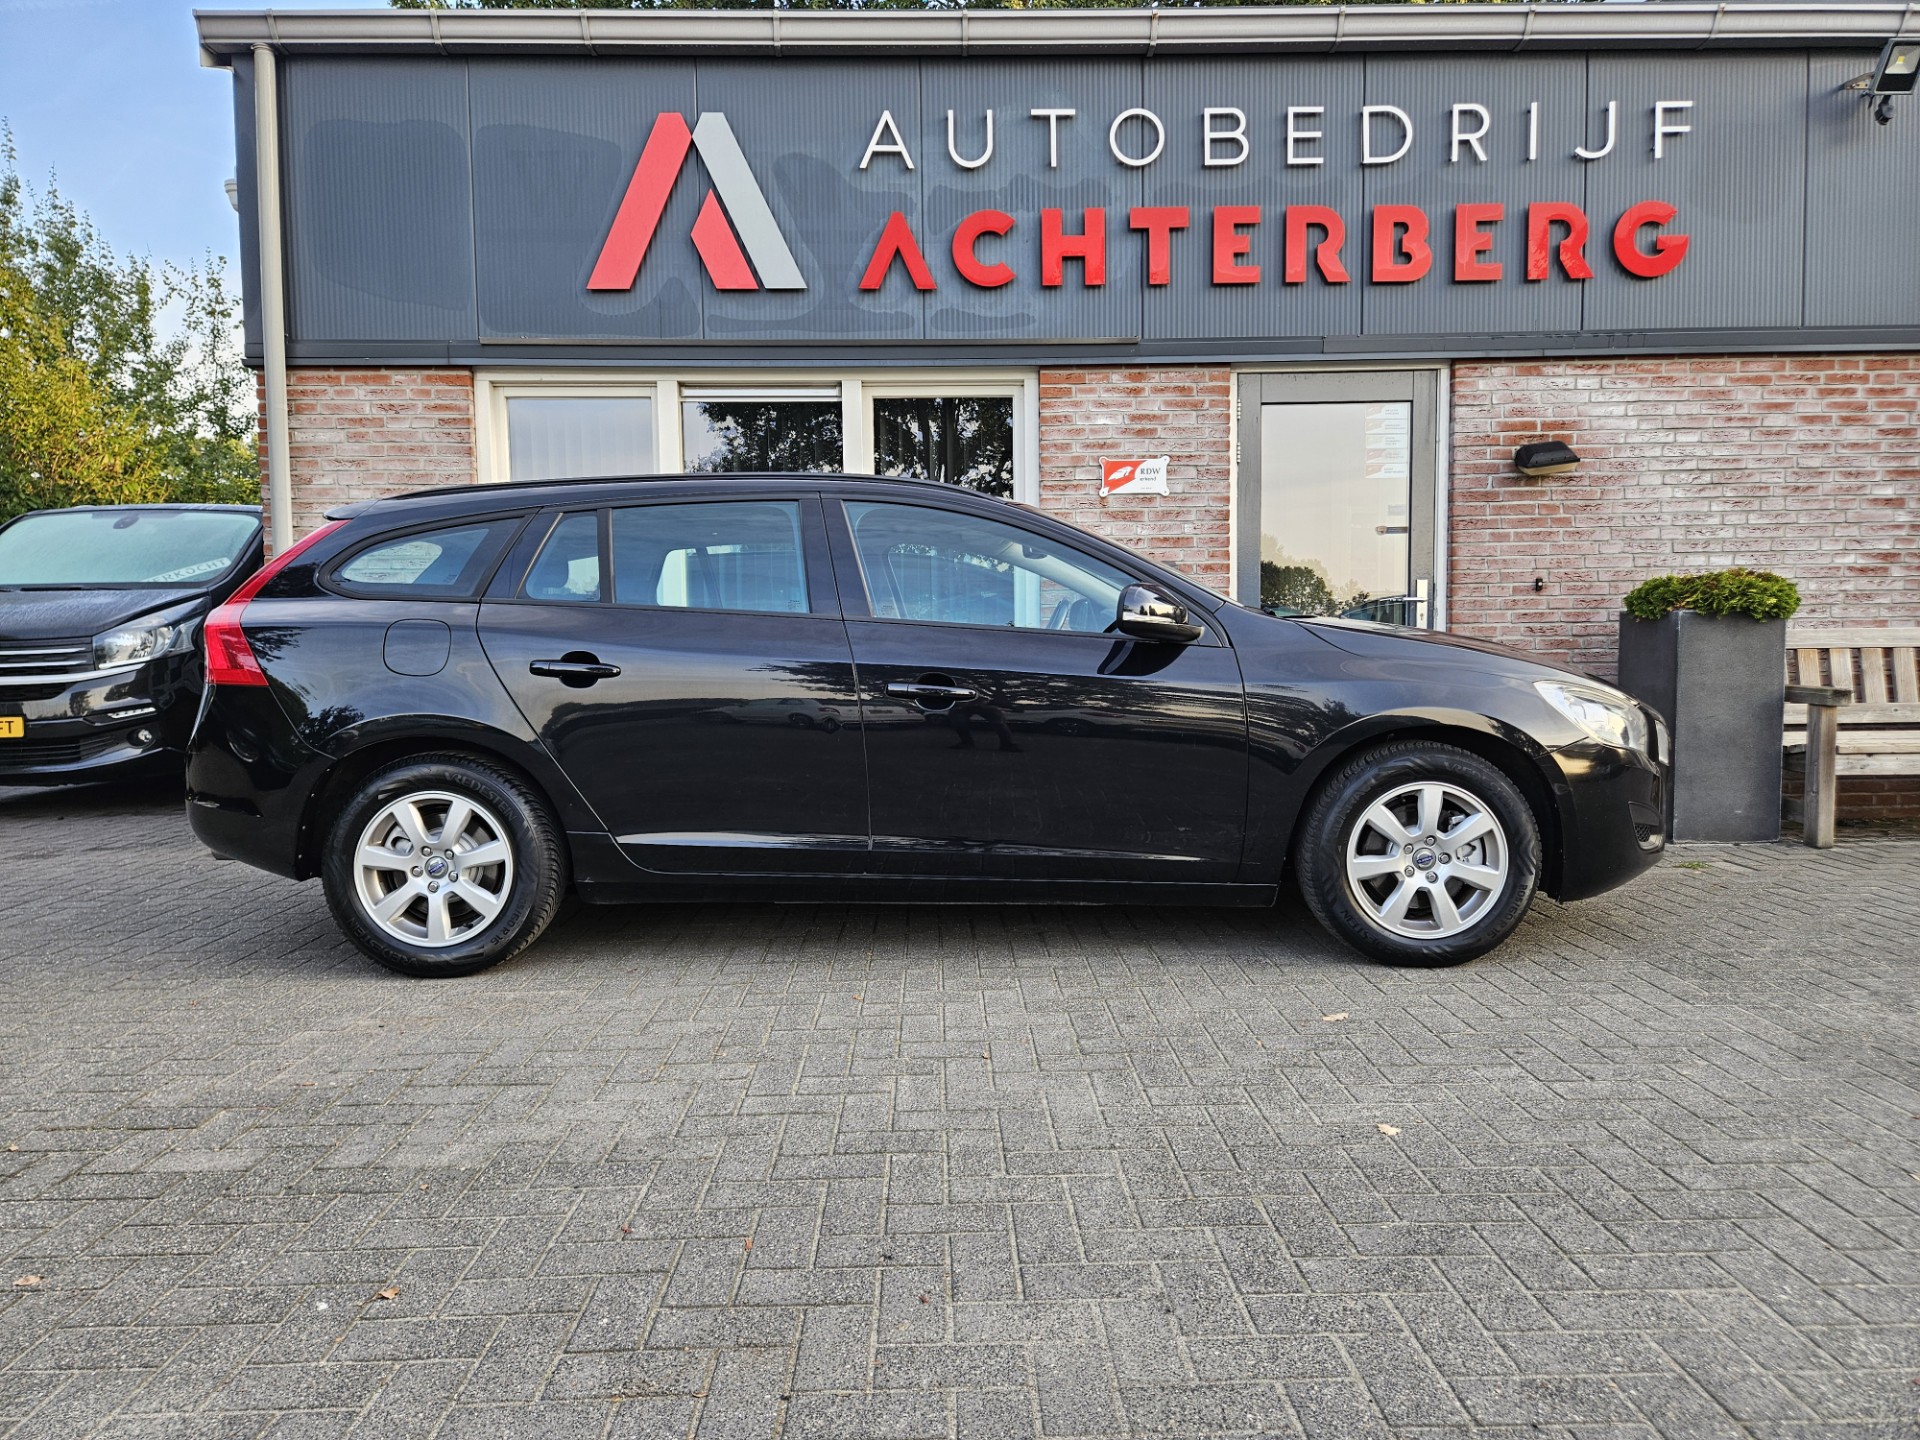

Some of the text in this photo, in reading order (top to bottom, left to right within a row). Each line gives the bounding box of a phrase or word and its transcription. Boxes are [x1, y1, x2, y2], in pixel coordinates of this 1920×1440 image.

[859, 100, 1693, 169] AUTOBEDRIJF
[859, 200, 1690, 290] ACHTERBERG
[1140, 467, 1161, 475] RDW
[148, 559, 226, 582] ERKOCHT
[444, 772, 518, 822] VREDESTEIN
